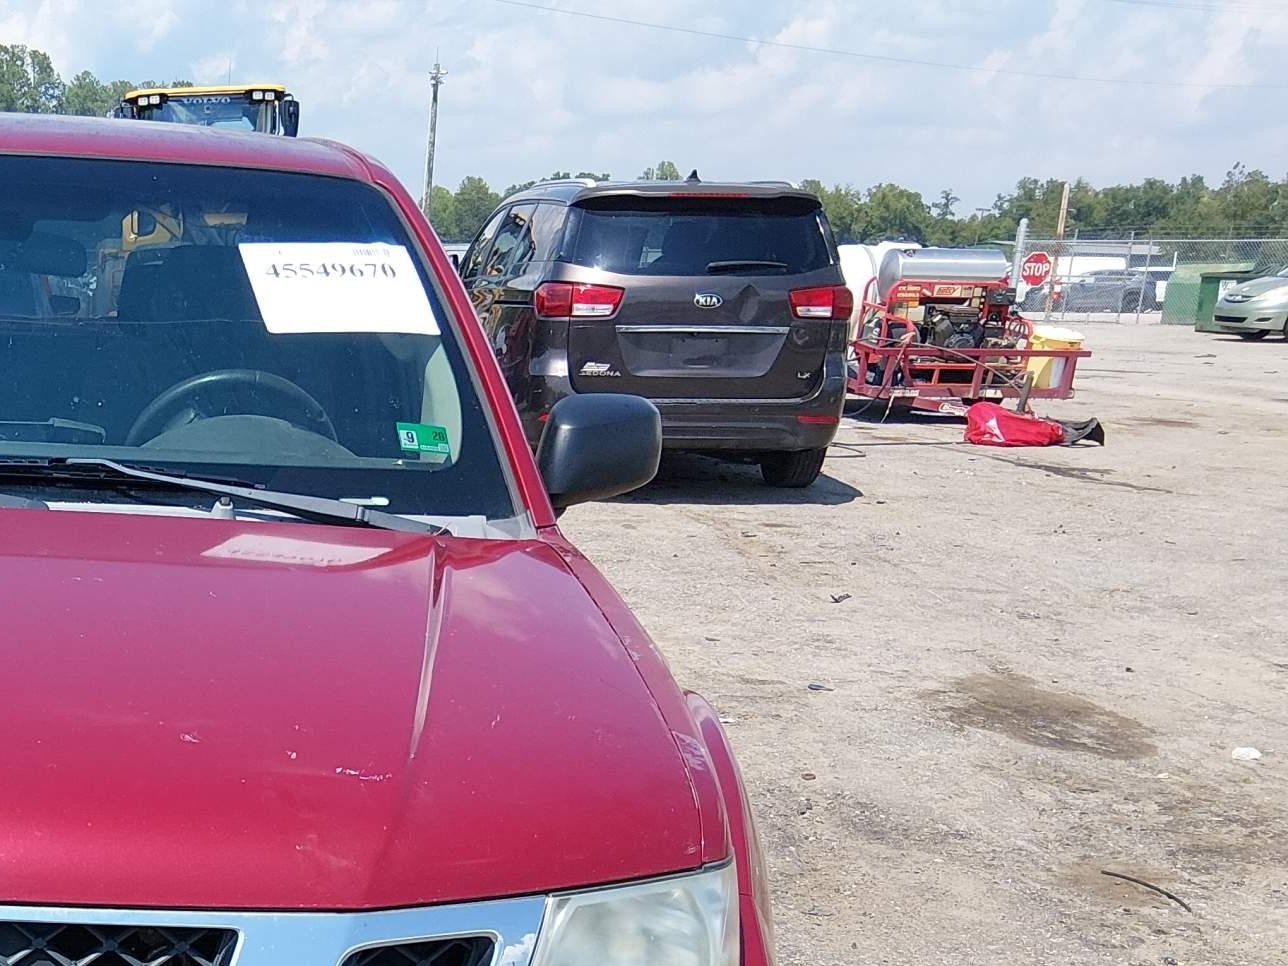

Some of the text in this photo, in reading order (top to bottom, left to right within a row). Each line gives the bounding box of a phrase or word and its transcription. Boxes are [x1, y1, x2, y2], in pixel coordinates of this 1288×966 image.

[181, 96, 231, 104] VOLVO
[265, 262, 398, 279] 45549670
[1022, 262, 1051, 277] STOP
[698, 296, 719, 306] KIA
